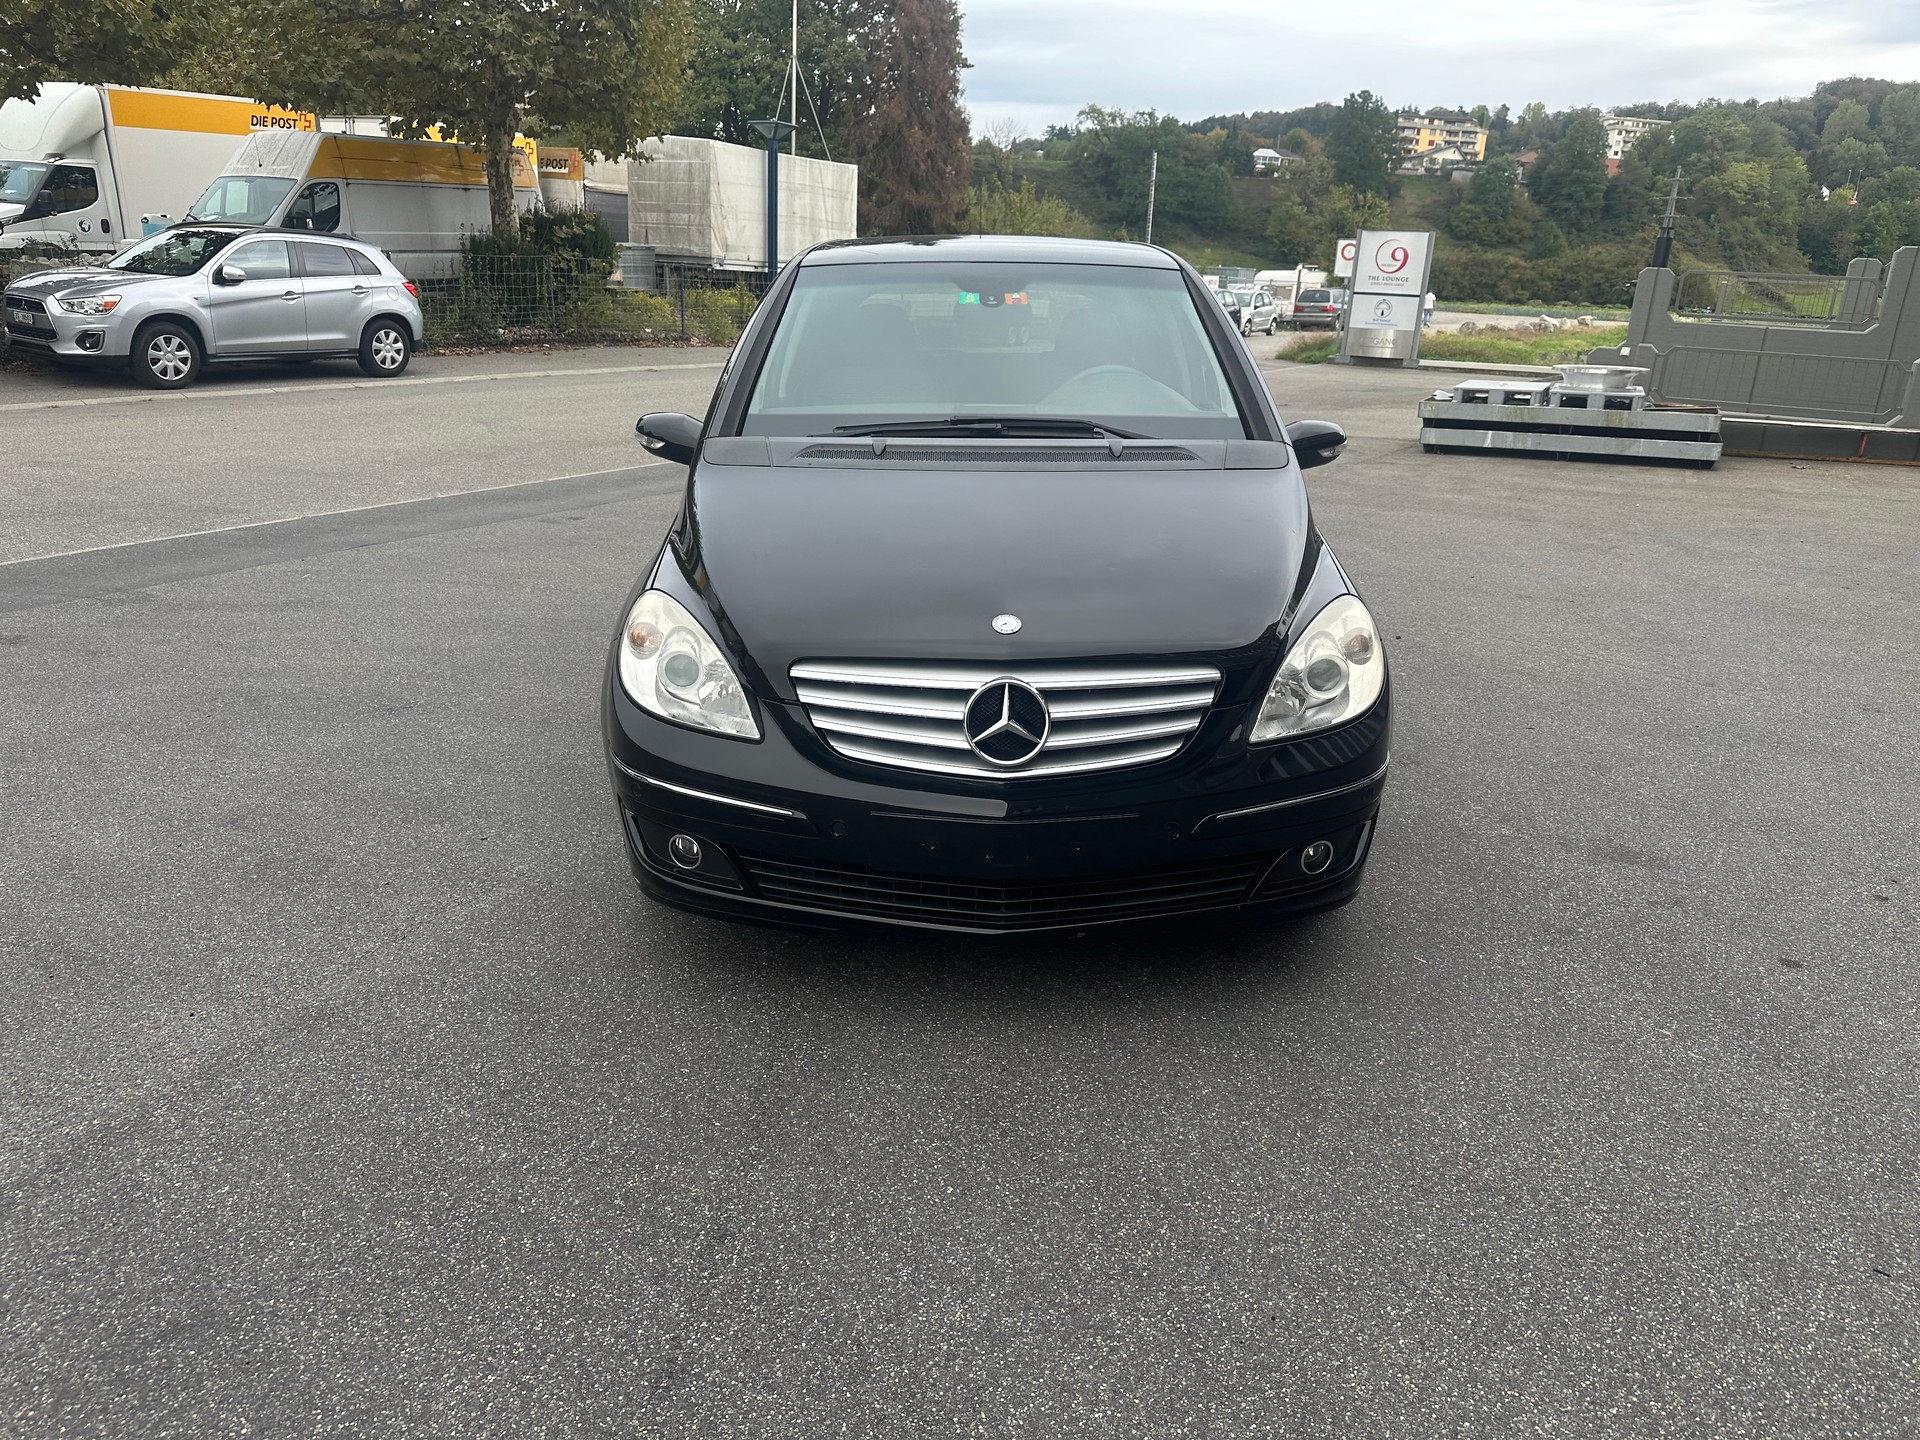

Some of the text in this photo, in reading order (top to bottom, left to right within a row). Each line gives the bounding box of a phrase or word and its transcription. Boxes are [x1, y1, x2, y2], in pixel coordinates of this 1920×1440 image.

[251, 115, 298, 129] DIE POST
[545, 158, 568, 169] POST
